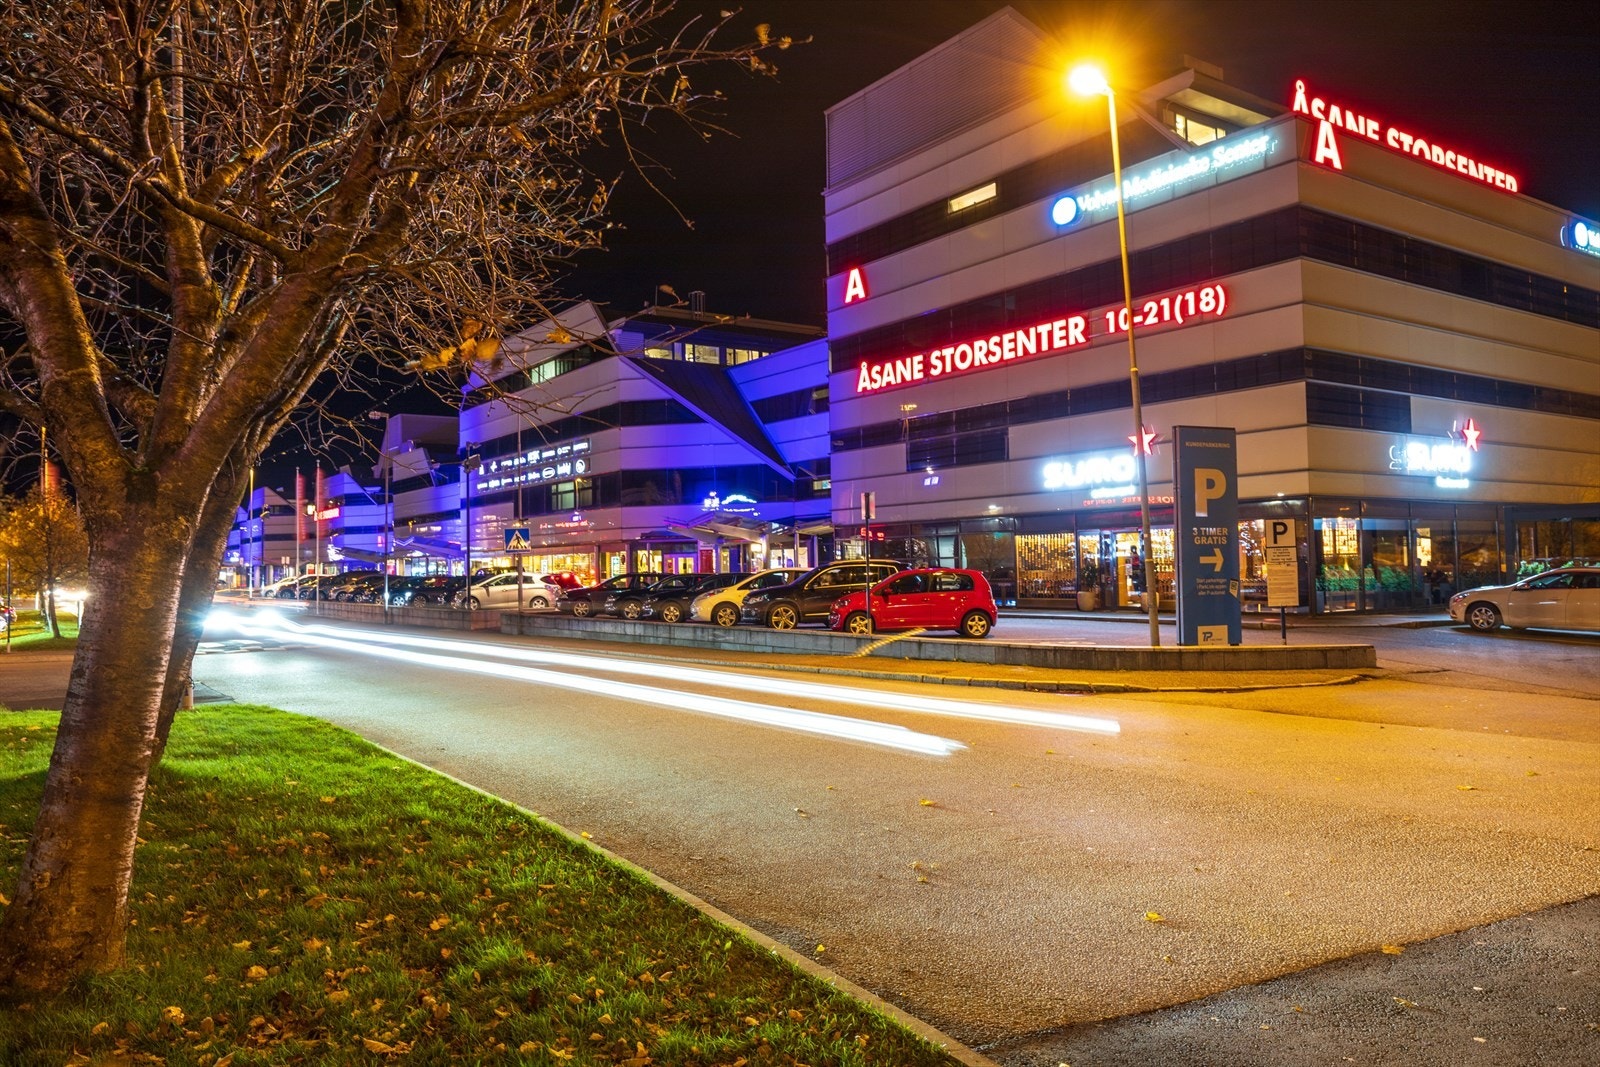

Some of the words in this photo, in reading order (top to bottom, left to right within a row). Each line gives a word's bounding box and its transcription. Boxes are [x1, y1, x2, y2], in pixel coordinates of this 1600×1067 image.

[1293, 80, 1380, 141] ÅSANE
[1387, 127, 1518, 193] STORSENTER
[1315, 119, 1342, 170] A
[845, 268, 866, 303] A
[857, 361, 924, 393] ÅSANE
[930, 315, 1087, 377] STORSENTER
[1105, 284, 1227, 333] 10-21(18)
[1185, 441, 1231, 449] KUNDEPARKERING
[1194, 468, 1226, 517] P
[1192, 527, 1198, 535] 3
[1200, 527, 1228, 535] TIMER
[1194, 537, 1227, 545] GRATIS
[1272, 521, 1288, 544] P
